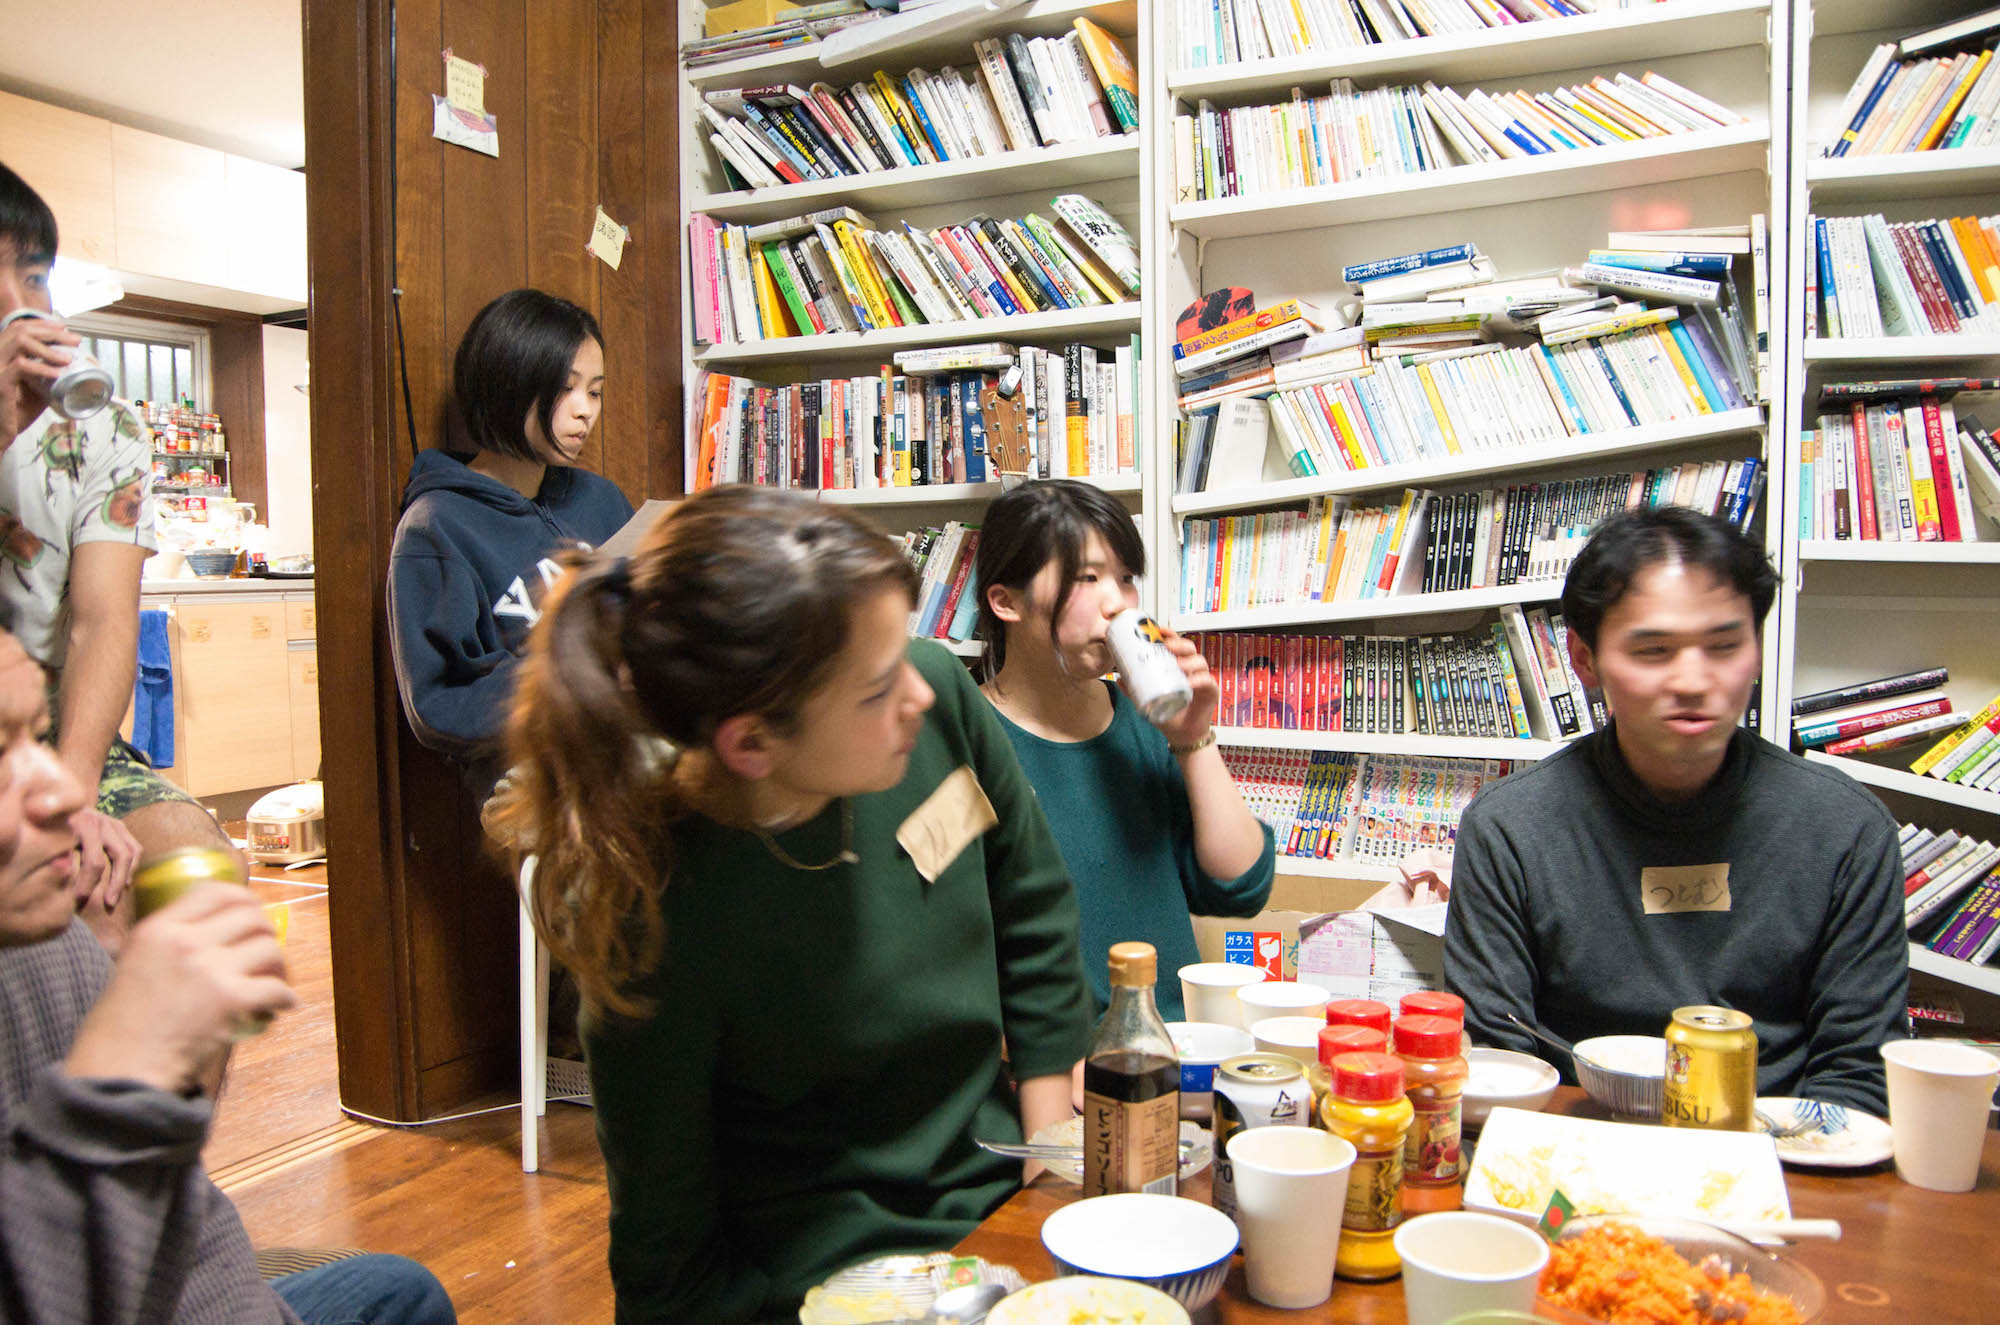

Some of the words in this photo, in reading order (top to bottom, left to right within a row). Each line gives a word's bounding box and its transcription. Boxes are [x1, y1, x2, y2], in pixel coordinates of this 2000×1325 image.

[1033, 224, 1062, 264] アフリカ
[1085, 221, 1117, 237] 教本
[776, 267, 794, 295] 秘伝
[1071, 345, 1080, 398] なぜ人と組織は
[967, 382, 977, 402] 日本の
[1729, 487, 1746, 522] 話し方入門
[1381, 648, 1389, 671] 火の鳥
[1394, 649, 1403, 672] 火の鳥
[1411, 646, 1420, 668] 火の鳥
[1426, 651, 1436, 674] 火の鳥
[1434, 645, 1444, 668] 火の鳥
[1447, 649, 1457, 671] 火の鳥
[1456, 645, 1466, 668] 火の鳥
[1467, 649, 1477, 672] 火の鳥
[1475, 646, 1486, 668] 火の鳥
[1488, 653, 1498, 676] 火の鳥
[1346, 769, 1357, 803] ラブひな
[1363, 766, 1374, 800] ラブひな
[1372, 768, 1383, 803] ラブひな
[1381, 770, 1392, 804] ラブひな
[1389, 770, 1400, 804] ラブひな
[1399, 769, 1410, 804] ラブひな
[1407, 771, 1418, 806] ラブひな
[1417, 771, 1428, 806] ラブひな
[1426, 773, 1436, 807] ラブひな
[1434, 773, 1444, 808] ラブひな
[1444, 774, 1454, 808] ラブひな
[1453, 774, 1464, 808] ラブひな
[1650, 877, 1724, 908] つとむ
[1226, 936, 1253, 946] ガラス
[1229, 953, 1251, 964] ビン
[1664, 1096, 1711, 1125] BISU
